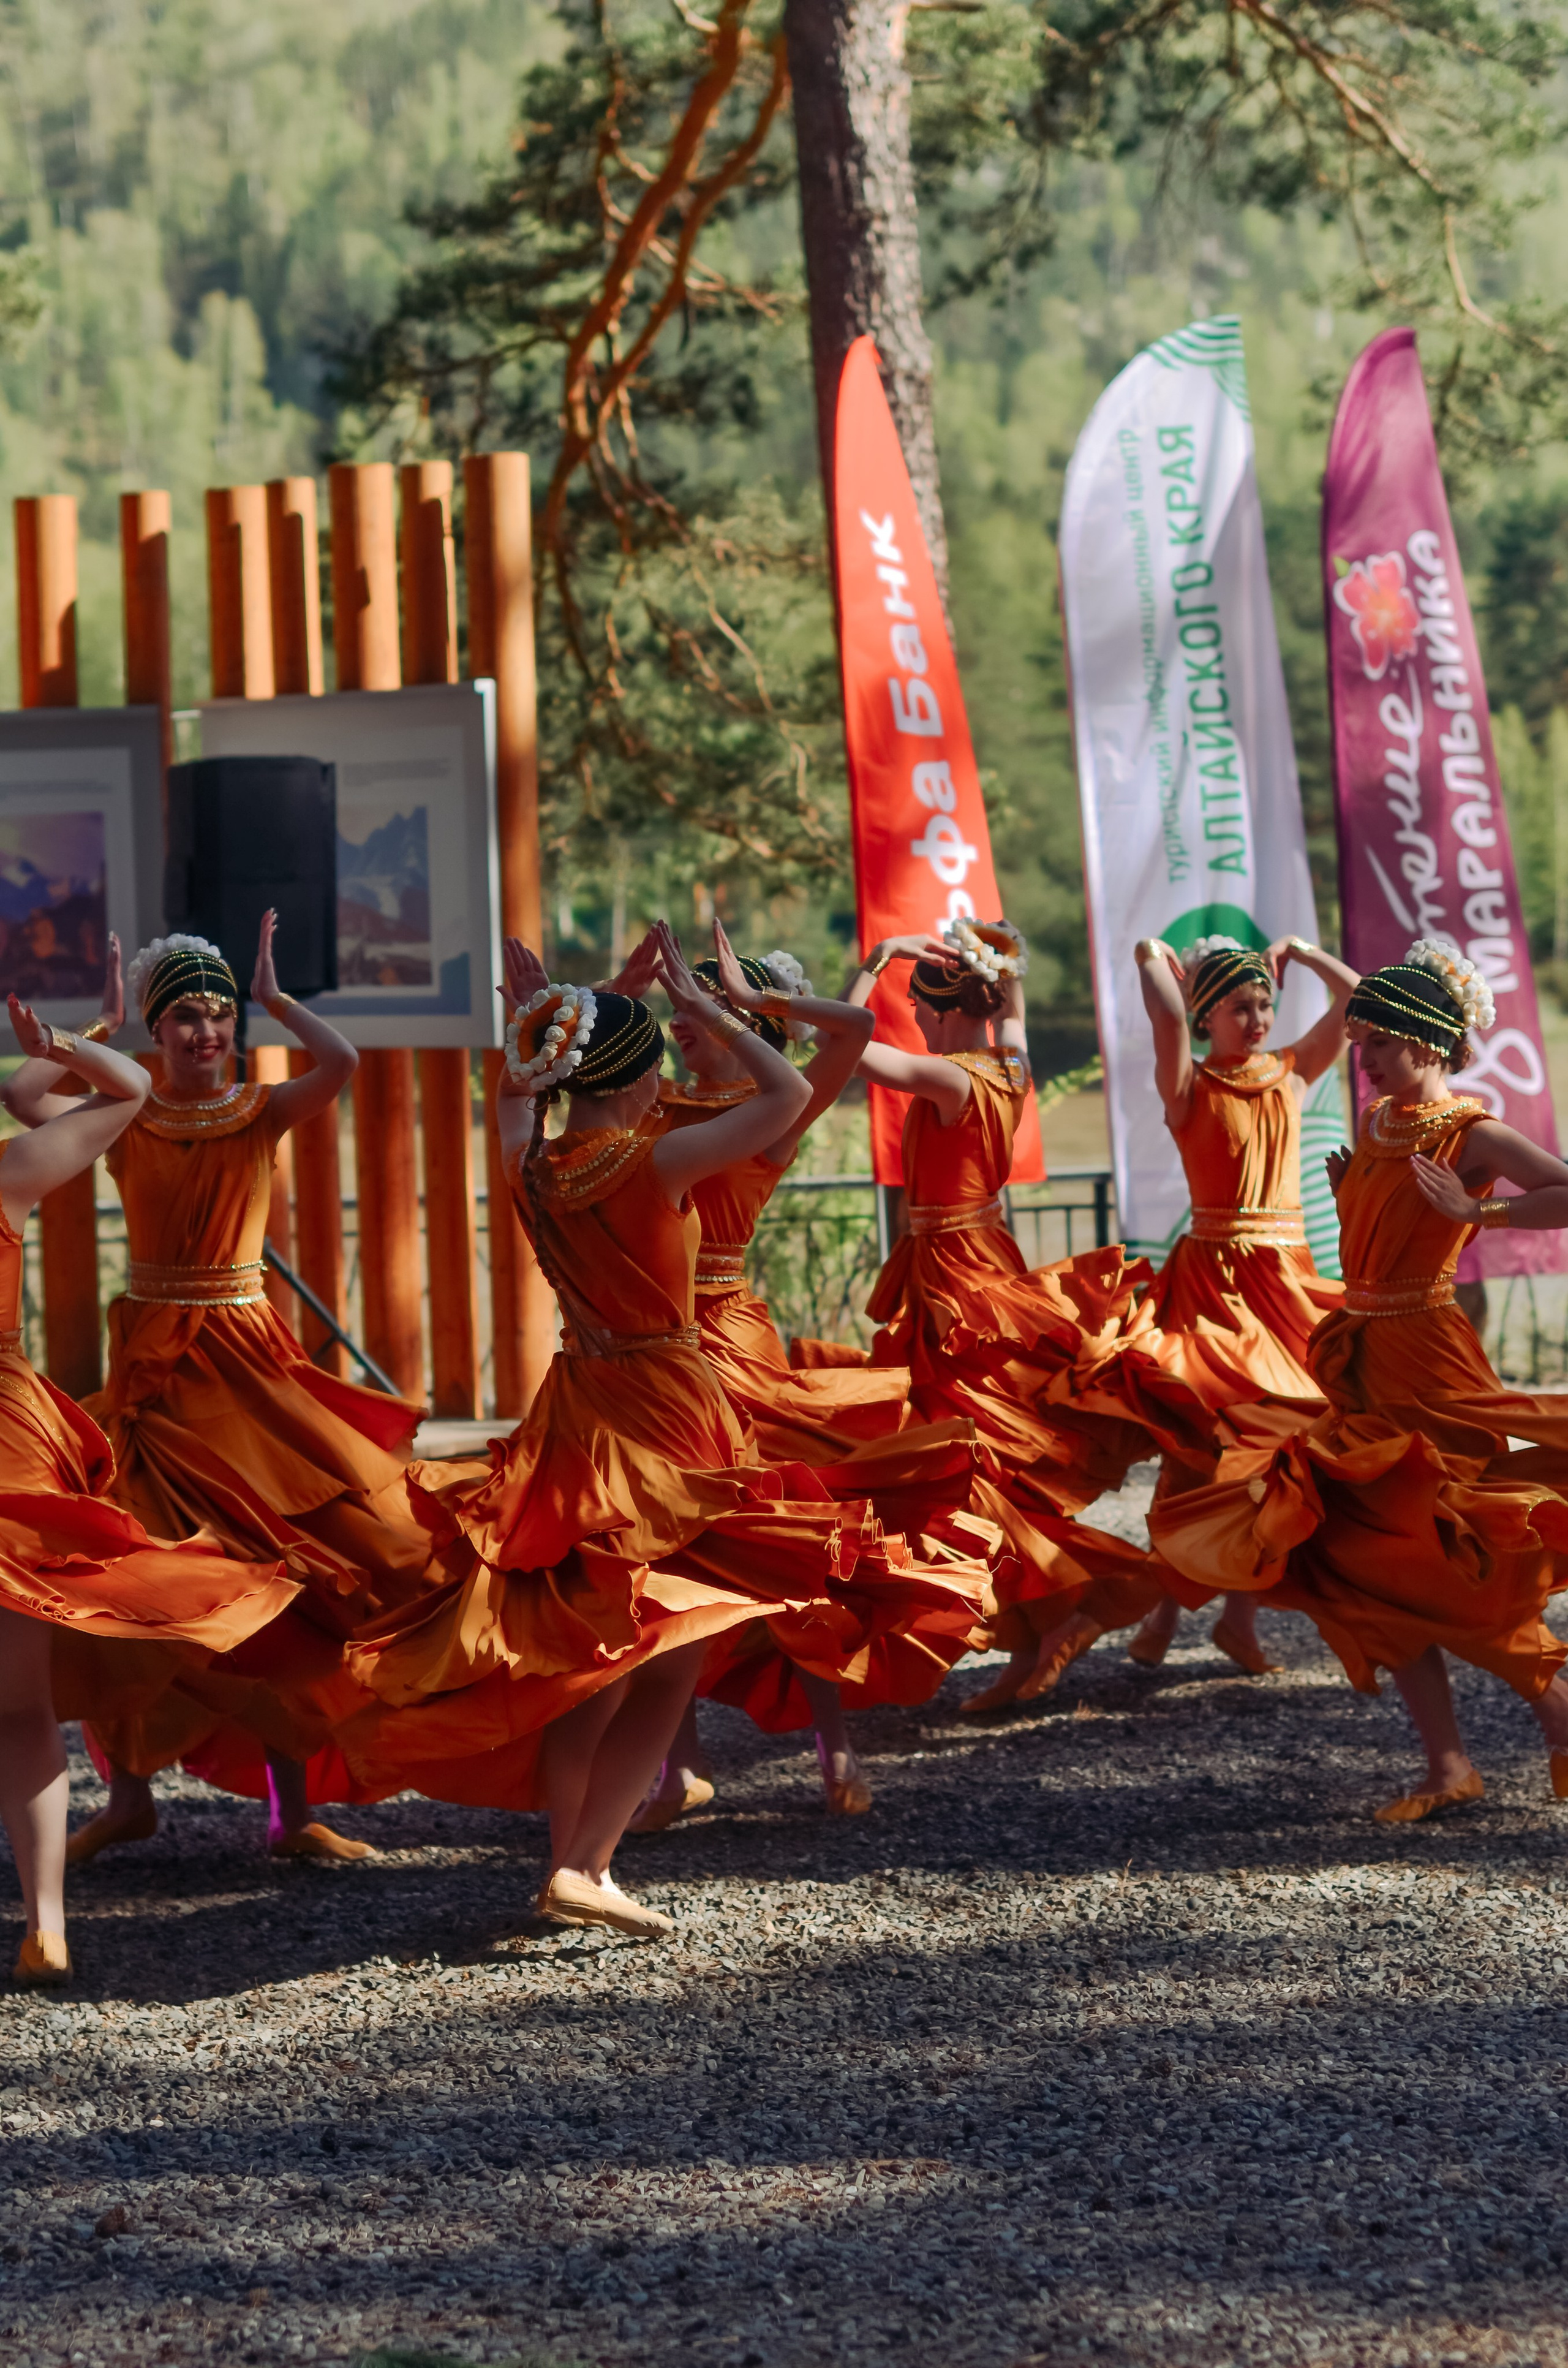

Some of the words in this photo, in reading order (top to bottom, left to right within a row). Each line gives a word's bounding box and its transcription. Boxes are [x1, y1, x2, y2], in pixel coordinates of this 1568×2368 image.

[1117, 428, 1144, 501] центр
[1156, 424, 1205, 547] КРАЯ
[860, 508, 944, 737] Банк
[1170, 560, 1248, 877] АЛТАЙСКОГО
[910, 758, 979, 936] ьфа
[1407, 529, 1520, 994] МАРАЛЬНИКА
